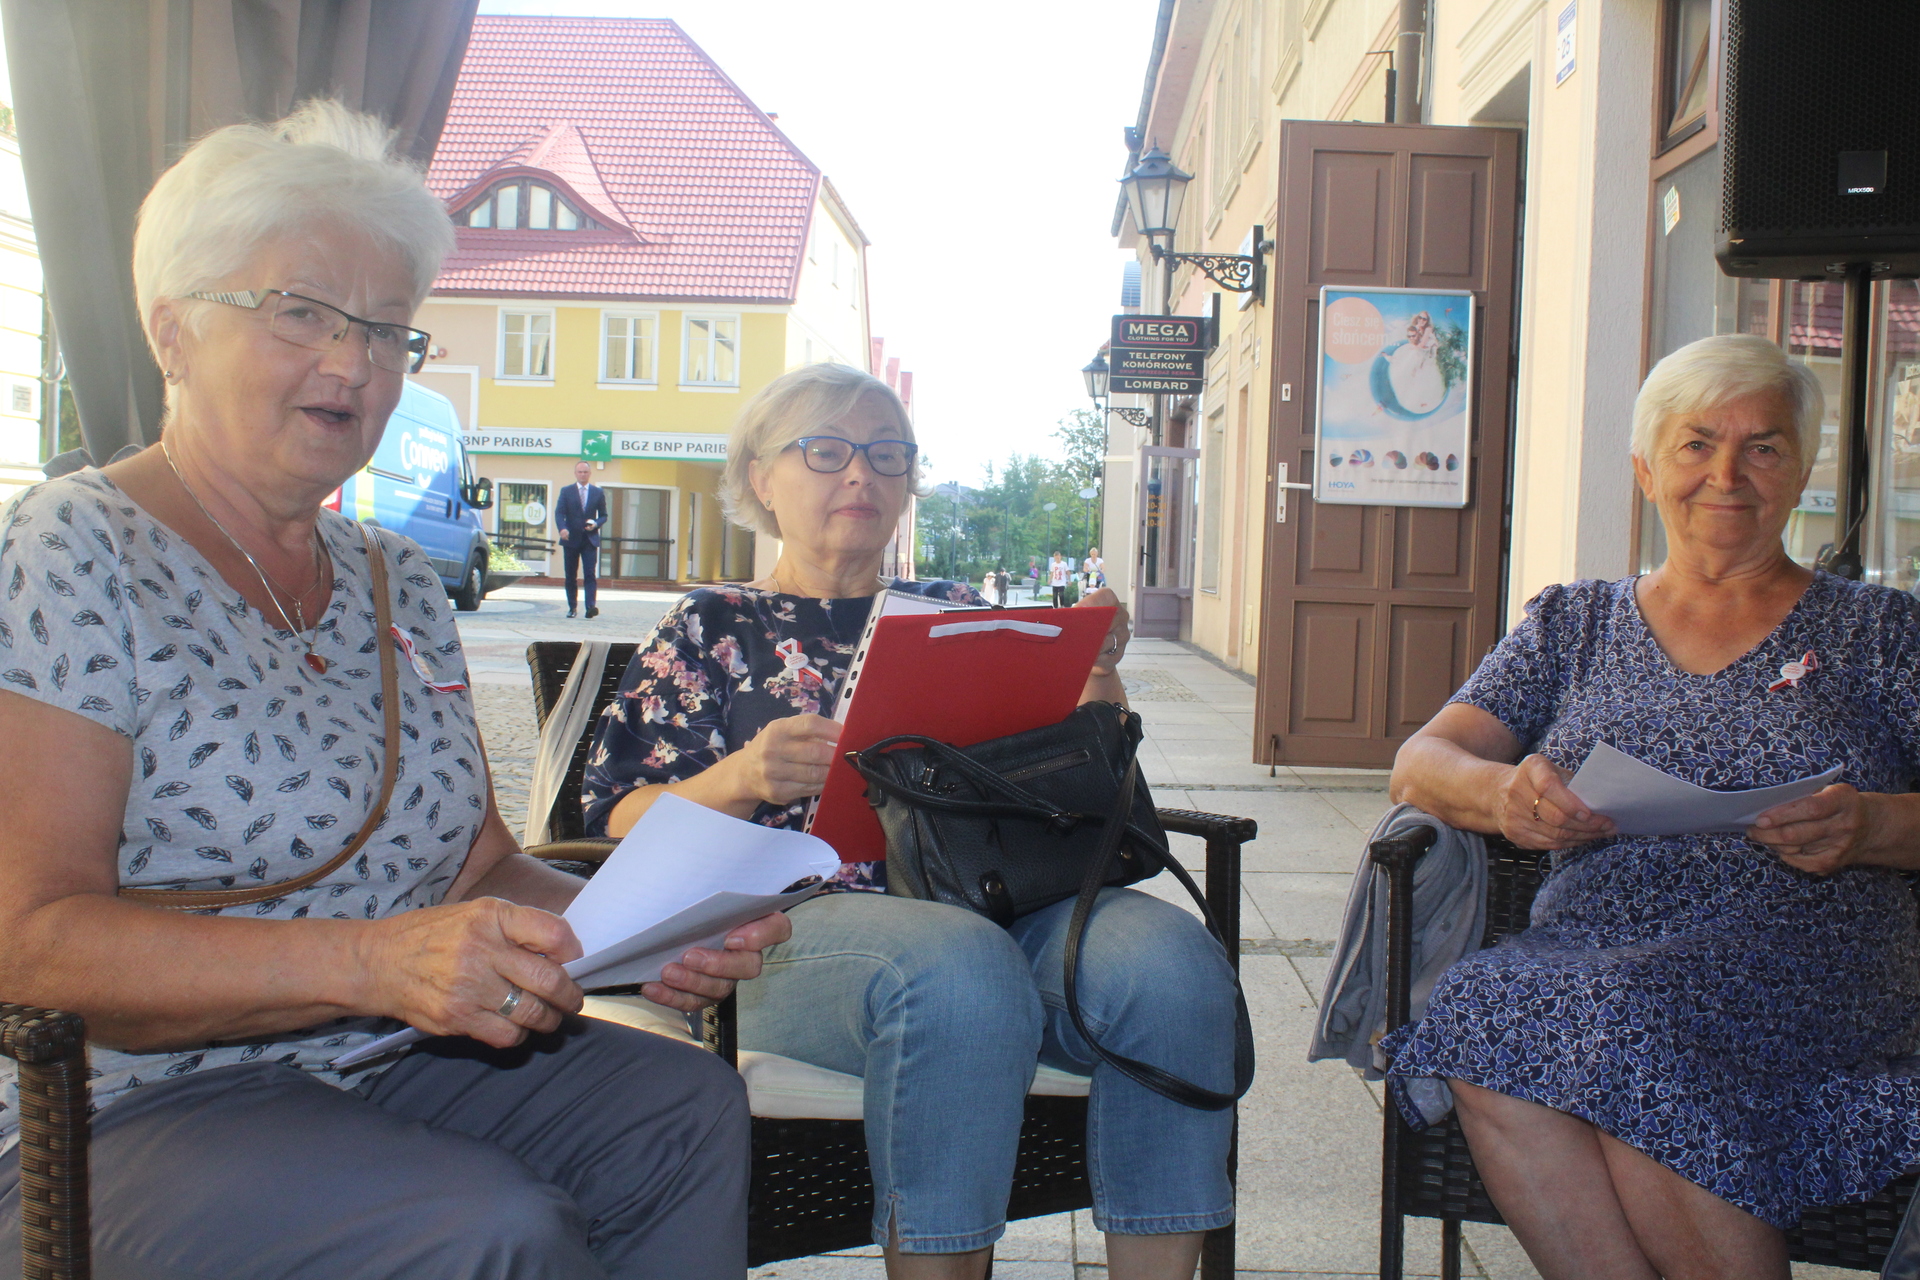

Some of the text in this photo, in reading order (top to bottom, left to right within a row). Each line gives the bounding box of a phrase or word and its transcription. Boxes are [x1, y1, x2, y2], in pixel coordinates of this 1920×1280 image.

[1333, 312, 1380, 329] Ciesz się
[1129, 323, 1189, 337] MEGA
[1129, 352, 1186, 360] TELEFONY
[1122, 360, 1193, 370] KOMÓRKOWE
[1124, 380, 1189, 390] LOMBARD
[463, 436, 552, 448] BNP PARIBAS
[653, 441, 683, 452] BNP
[1328, 481, 1355, 489] HOYA
